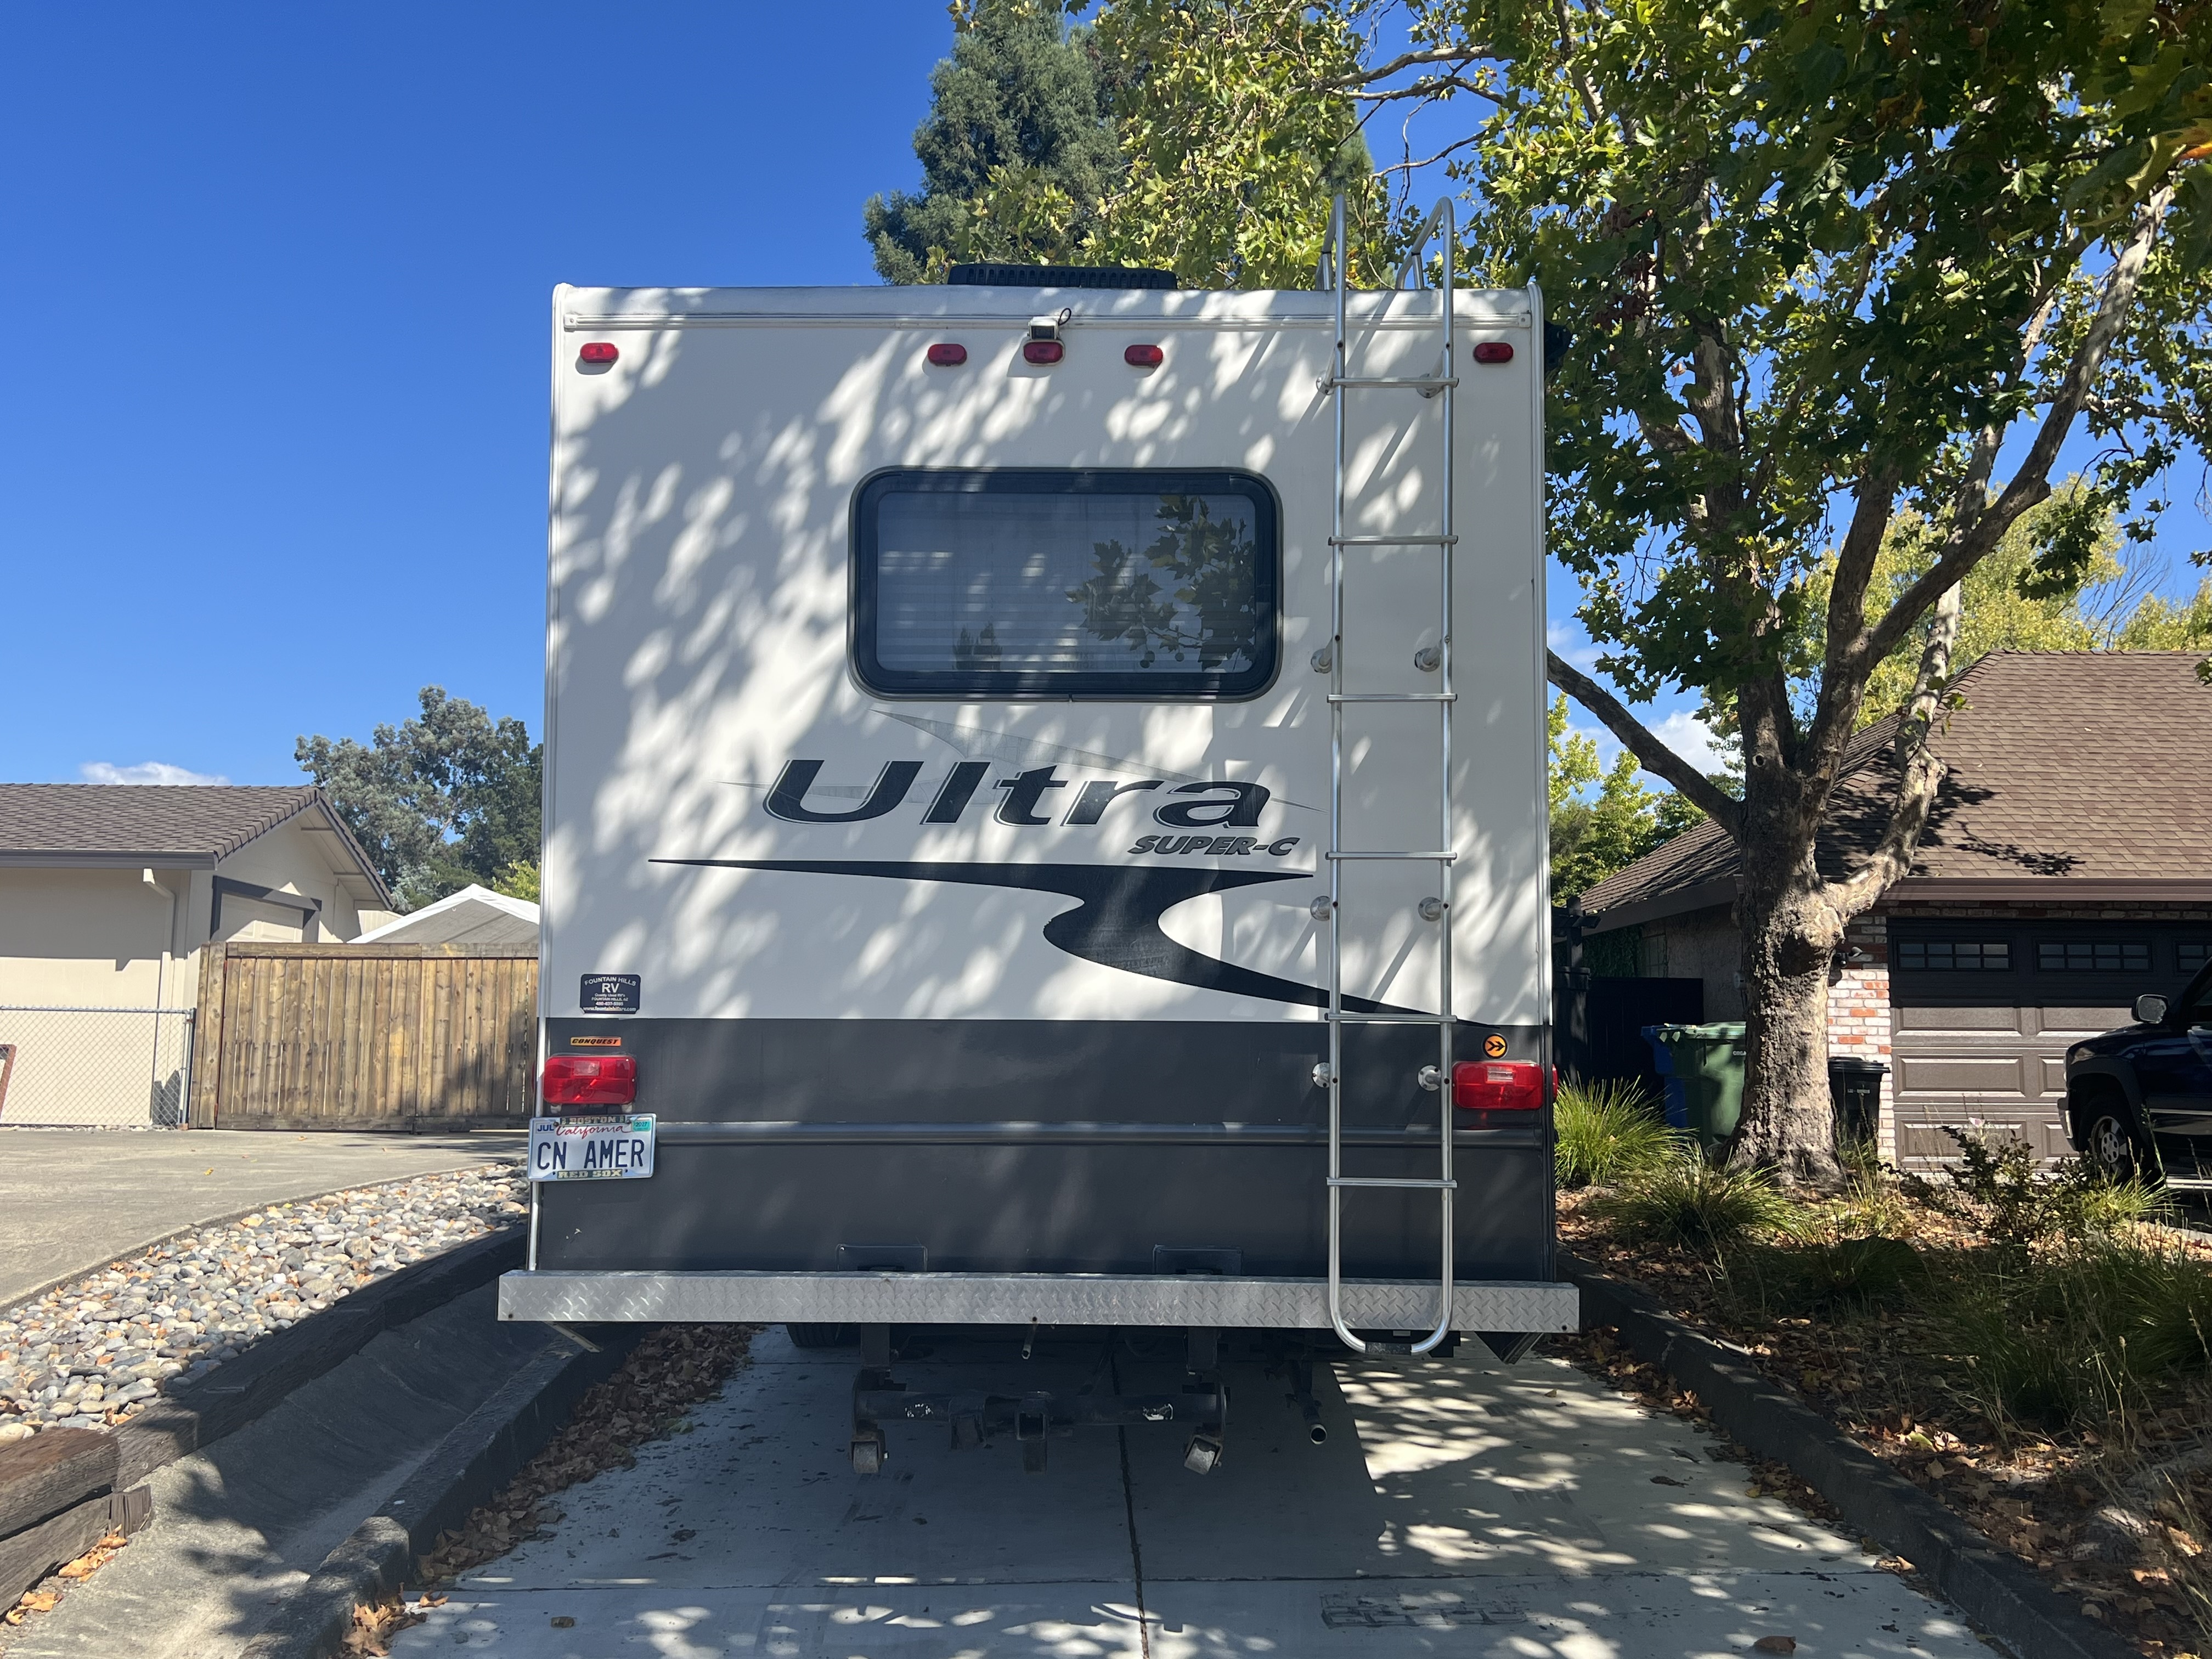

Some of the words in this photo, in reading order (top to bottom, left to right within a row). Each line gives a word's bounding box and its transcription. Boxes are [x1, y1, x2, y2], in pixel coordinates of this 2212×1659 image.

[762, 759, 1272, 828] Ultra
[1126, 835, 1300, 856] SUPER-C
[584, 977, 617, 986] FOUNTAIN
[618, 977, 636, 986] HILLS
[602, 983, 619, 992] RV
[569, 1116, 617, 1125] BOSTON
[556, 1125, 631, 1139] California
[538, 1142, 567, 1170] CN
[584, 1139, 644, 1168] AMER
[558, 1170, 589, 1178] RED
[592, 1169, 622, 1177] SOX
